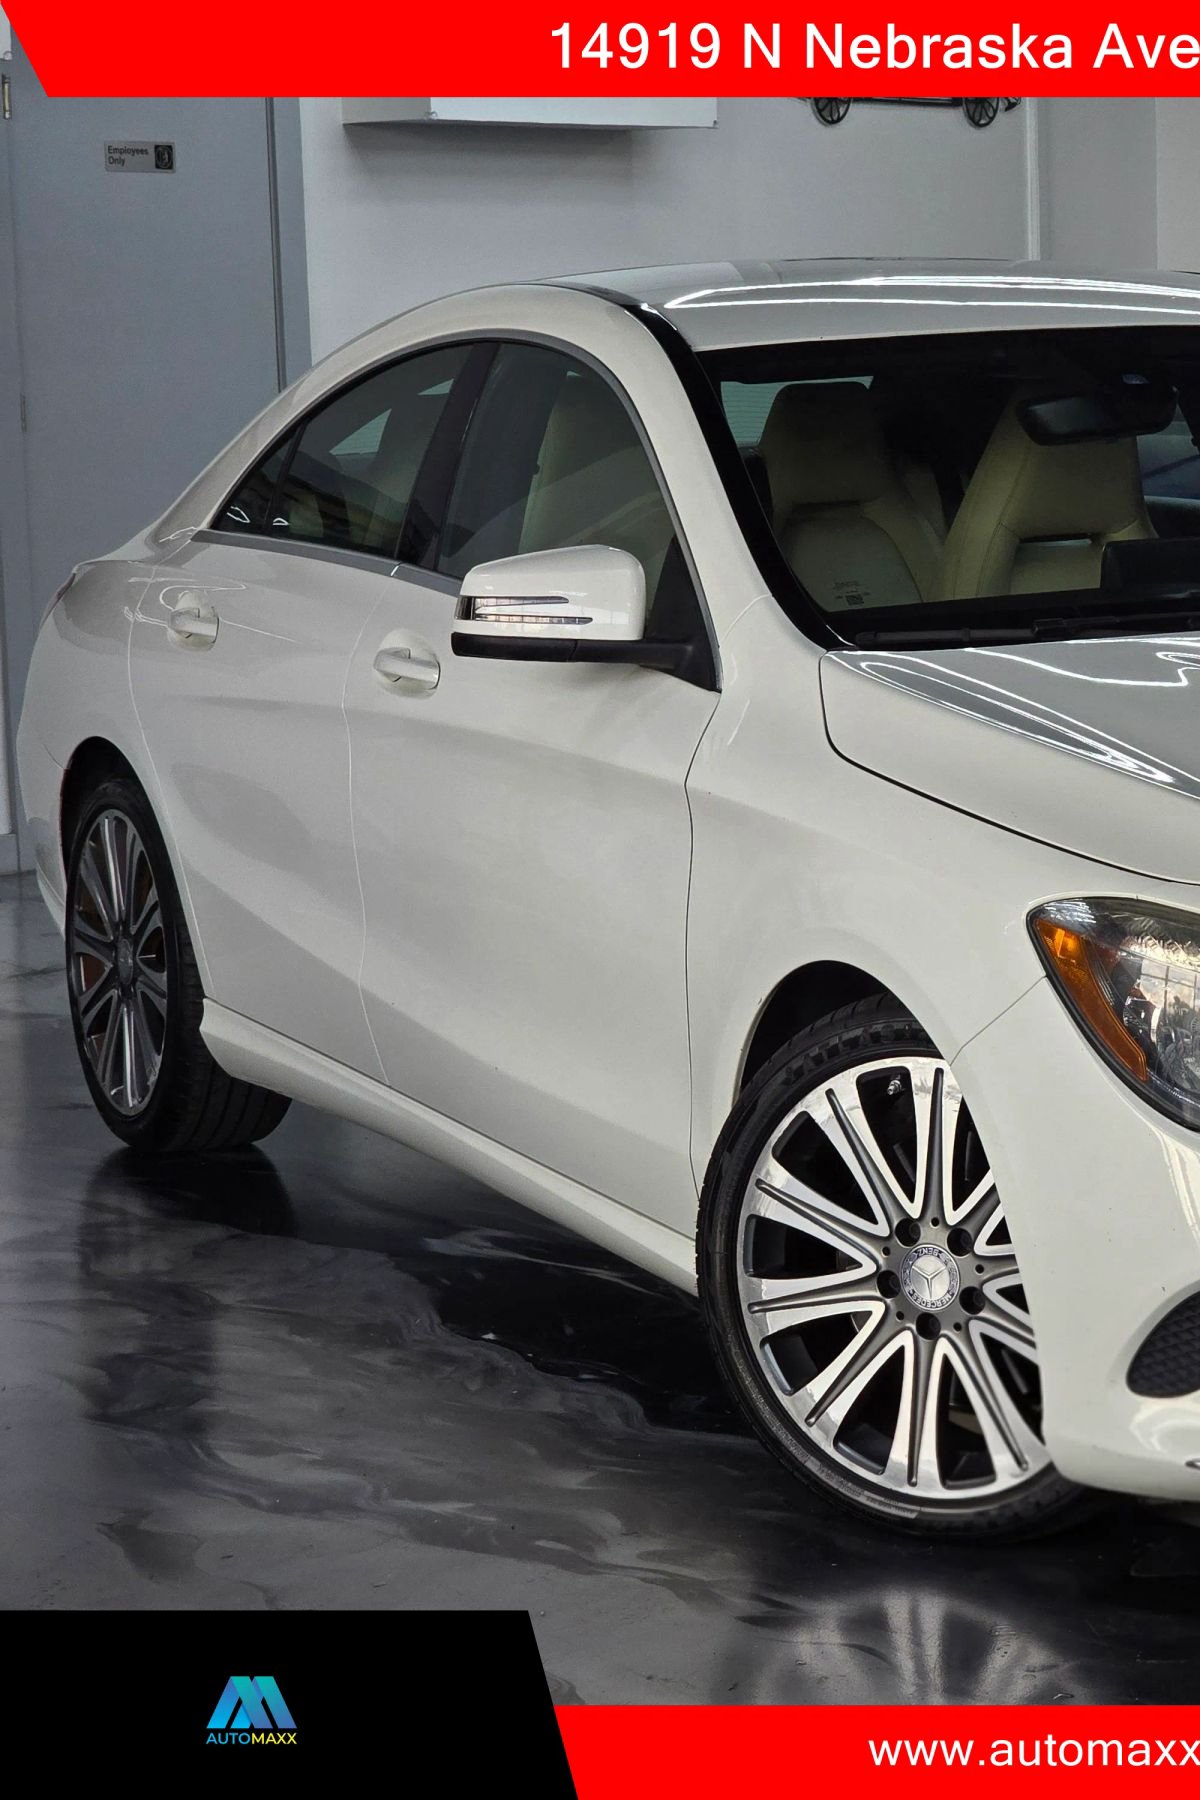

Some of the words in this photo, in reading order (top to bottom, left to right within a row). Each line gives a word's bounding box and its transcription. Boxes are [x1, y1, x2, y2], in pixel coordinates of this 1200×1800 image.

[107, 145, 149, 156] Employees
[108, 156, 126, 167] Only
[917, 1247, 939, 1257] BENZ
[911, 1292, 952, 1308] MERCEDES
